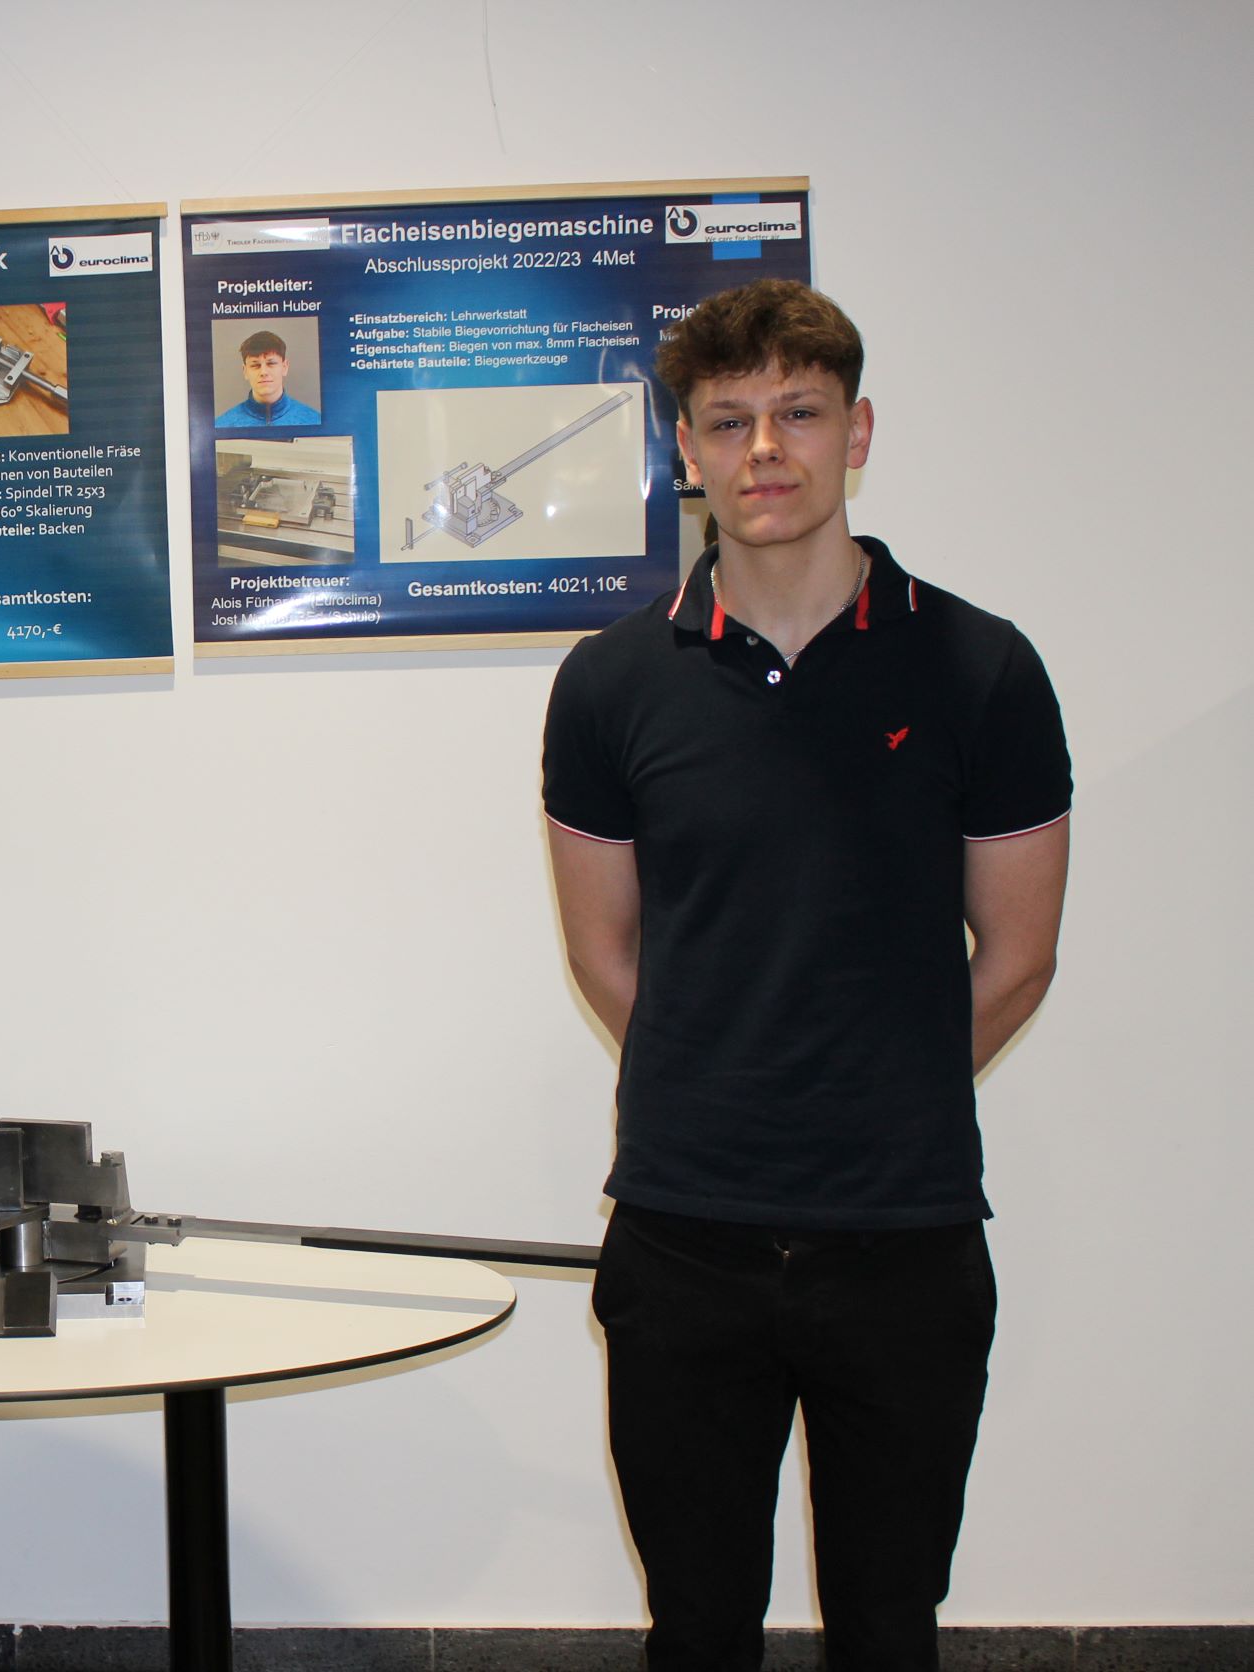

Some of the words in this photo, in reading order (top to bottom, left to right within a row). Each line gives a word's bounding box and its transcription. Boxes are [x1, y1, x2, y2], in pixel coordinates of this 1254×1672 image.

[341, 214, 654, 244] Flacheisenbiegemaschine
[704, 221, 796, 234] euroclima
[79, 254, 150, 268] euroclima
[364, 254, 509, 275] Abschlussprojekt
[512, 251, 582, 270] 2022/23
[592, 249, 636, 266] 4Met
[217, 278, 313, 297] Projektleiter:
[212, 302, 279, 315] Maximilian
[282, 300, 321, 312] Huber
[355, 311, 448, 325] Einsatzbereich:
[450, 309, 527, 322] Lehrwerkstatt
[355, 328, 409, 342] Aufgabe:
[412, 326, 452, 339] Stabile
[455, 323, 550, 338] Biegevorrichtung
[552, 321, 569, 334] für
[571, 320, 633, 333] Flacheisen
[355, 342, 446, 357] Eigenschaften:
[449, 340, 488, 354] Biegen
[491, 341, 512, 351] von
[515, 340, 543, 350] max.
[546, 337, 575, 349] 8mm
[578, 335, 640, 348] Flacheisen
[356, 357, 415, 370] Gehärtete
[418, 355, 472, 369] Bauteile:
[474, 353, 569, 368] Biegewerkzeuge
[8, 447, 104, 462] Konventionelle
[107, 445, 141, 458] Fräse
[27, 470, 50, 480] von
[53, 465, 113, 479] Bauteilen
[5, 485, 53, 501] Spindel
[55, 485, 73, 497] TR
[76, 485, 106, 499] 25x3
[25, 503, 93, 519] Skalierung
[38, 522, 85, 535] Backen
[230, 575, 350, 592] Projektbetreuer:
[407, 579, 543, 597] Gesamtkosten:
[548, 575, 628, 595] 4021,10€
[211, 597, 242, 609] Alois
[211, 614, 238, 626] Jost
[6, 623, 62, 640] 4170,-€
